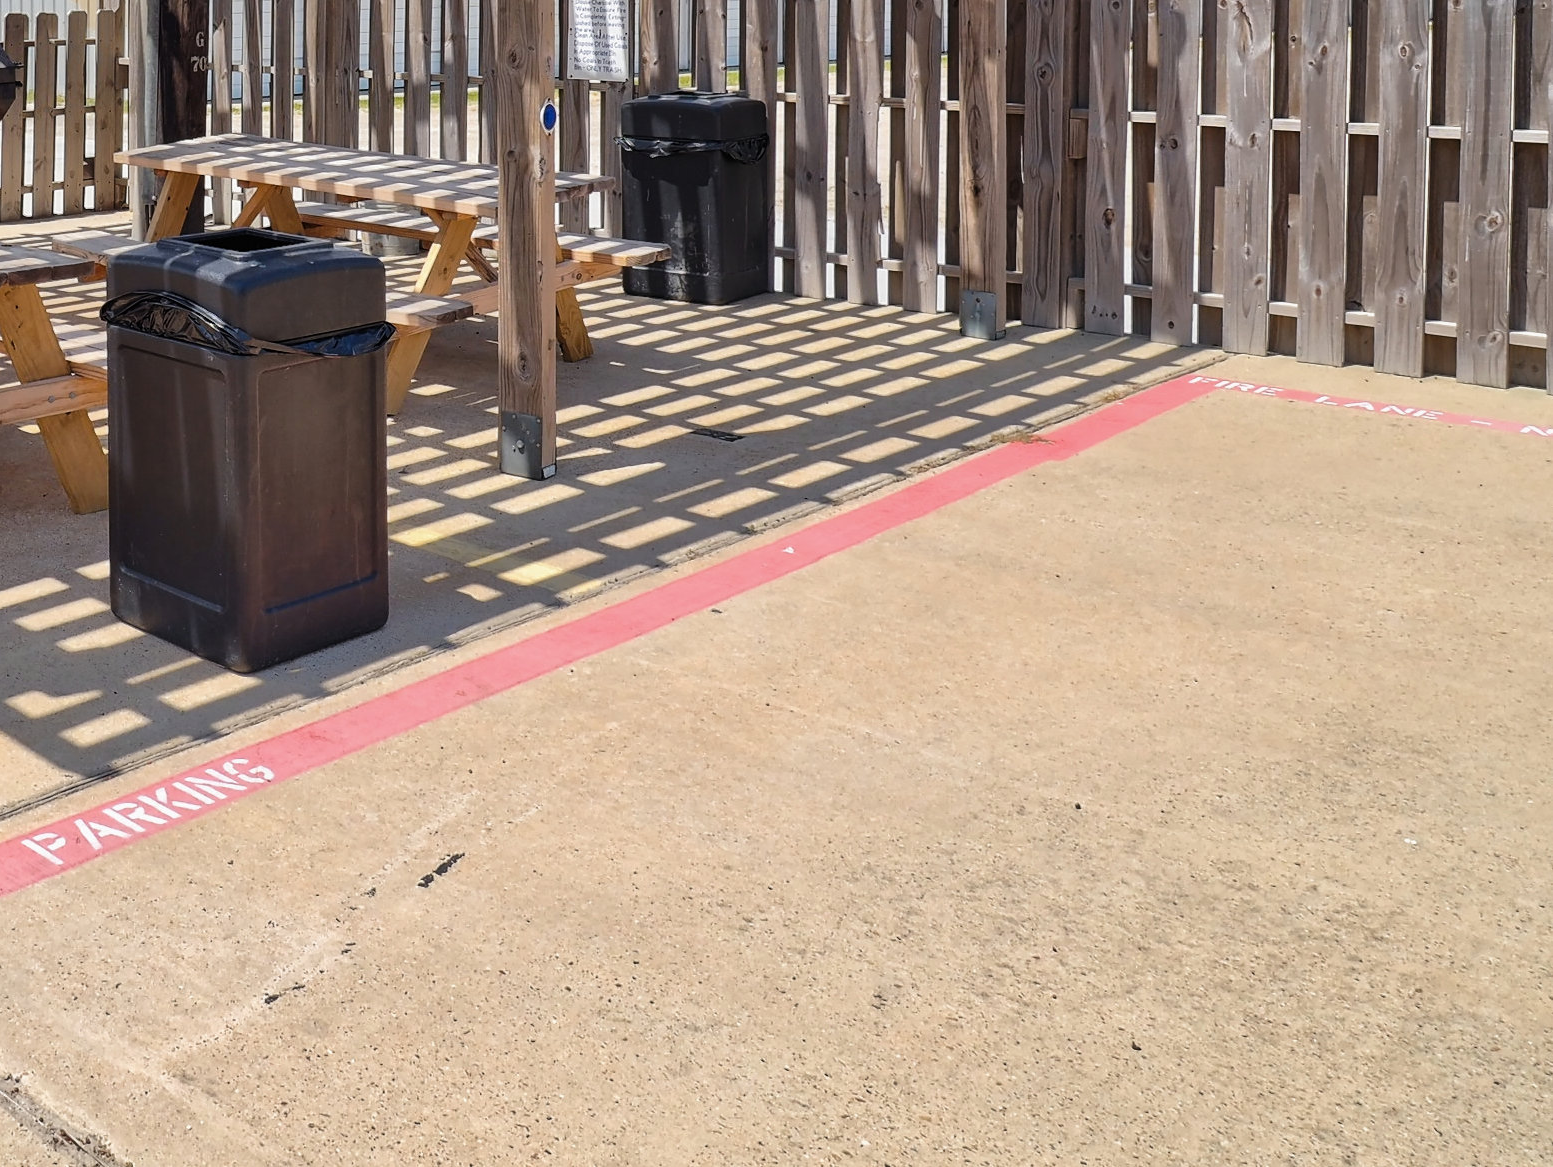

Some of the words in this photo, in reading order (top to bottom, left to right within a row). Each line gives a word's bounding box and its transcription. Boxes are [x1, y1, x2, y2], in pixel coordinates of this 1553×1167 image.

[196, 32, 204, 48] G
[190, 56, 207, 72] 70
[1187, 376, 1283, 396] FIRE
[1314, 395, 1444, 420] LANE
[20, 756, 276, 866] PARKING
